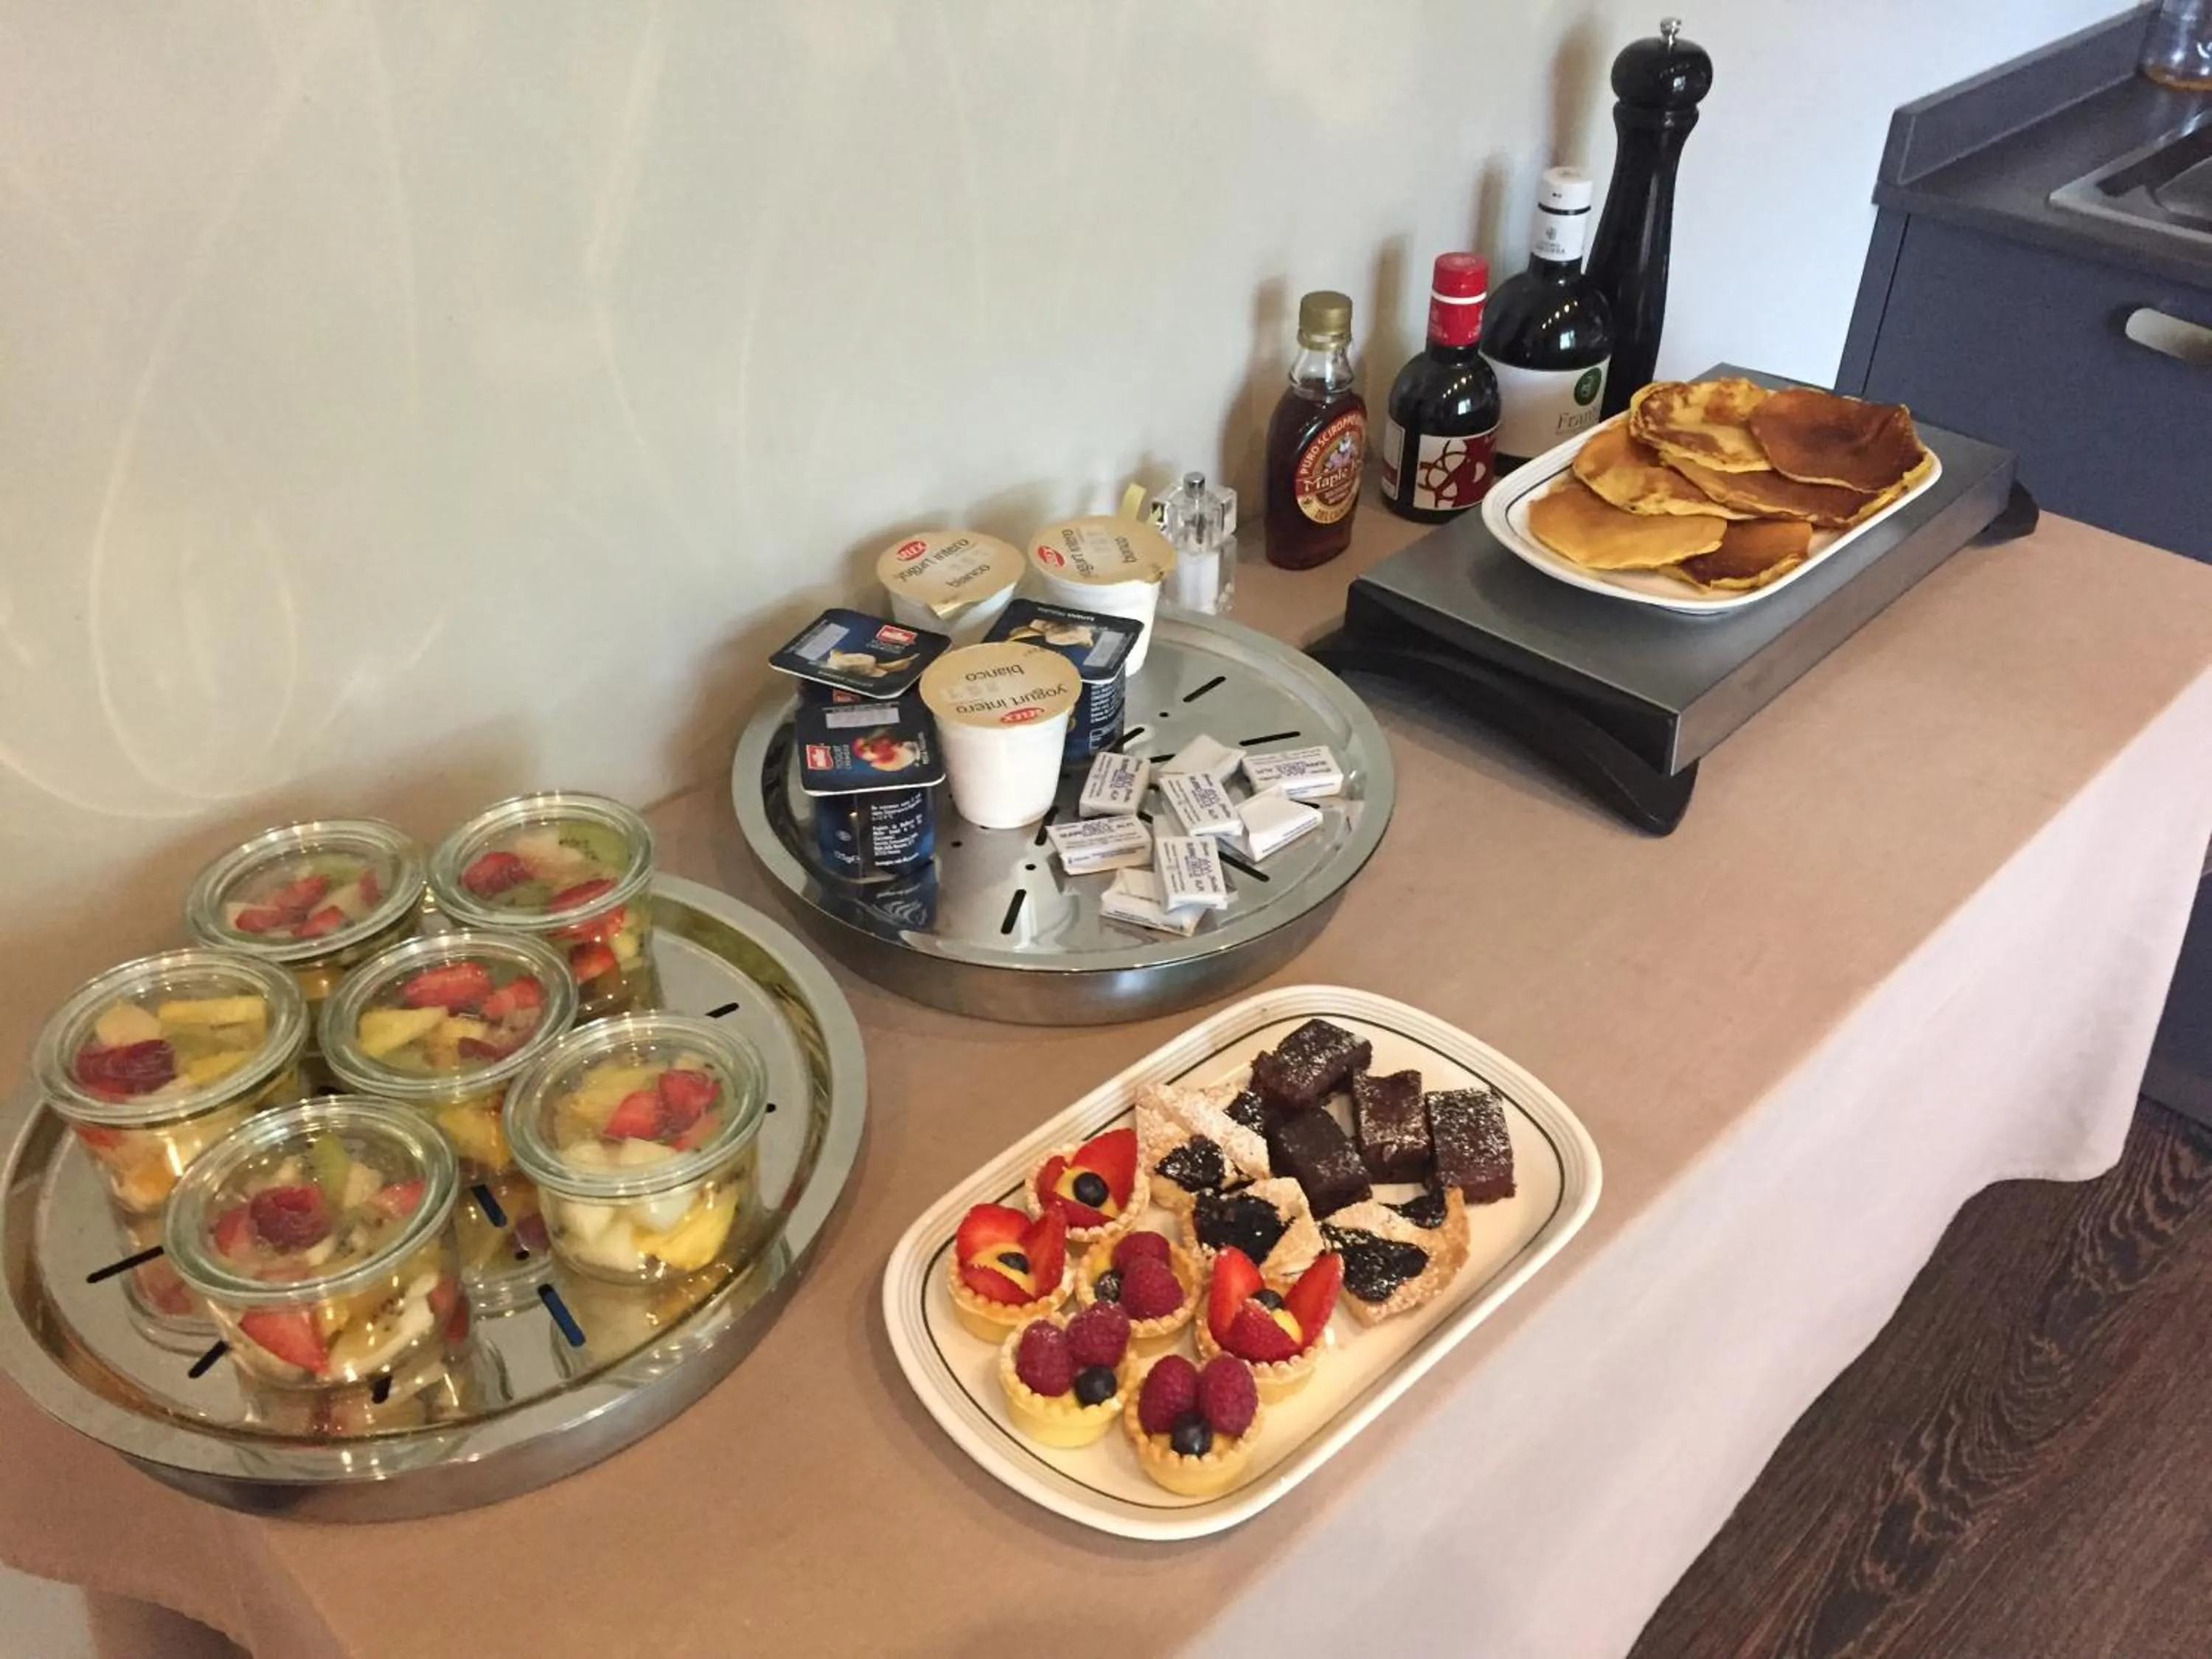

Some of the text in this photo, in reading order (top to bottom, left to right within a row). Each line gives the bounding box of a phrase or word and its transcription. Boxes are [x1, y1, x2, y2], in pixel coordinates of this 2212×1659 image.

[1300, 445, 1320, 475] PURO
[945, 564, 991, 588] bianco
[964, 664, 1026, 681] bianco
[956, 683, 1068, 714] yogurt intero
